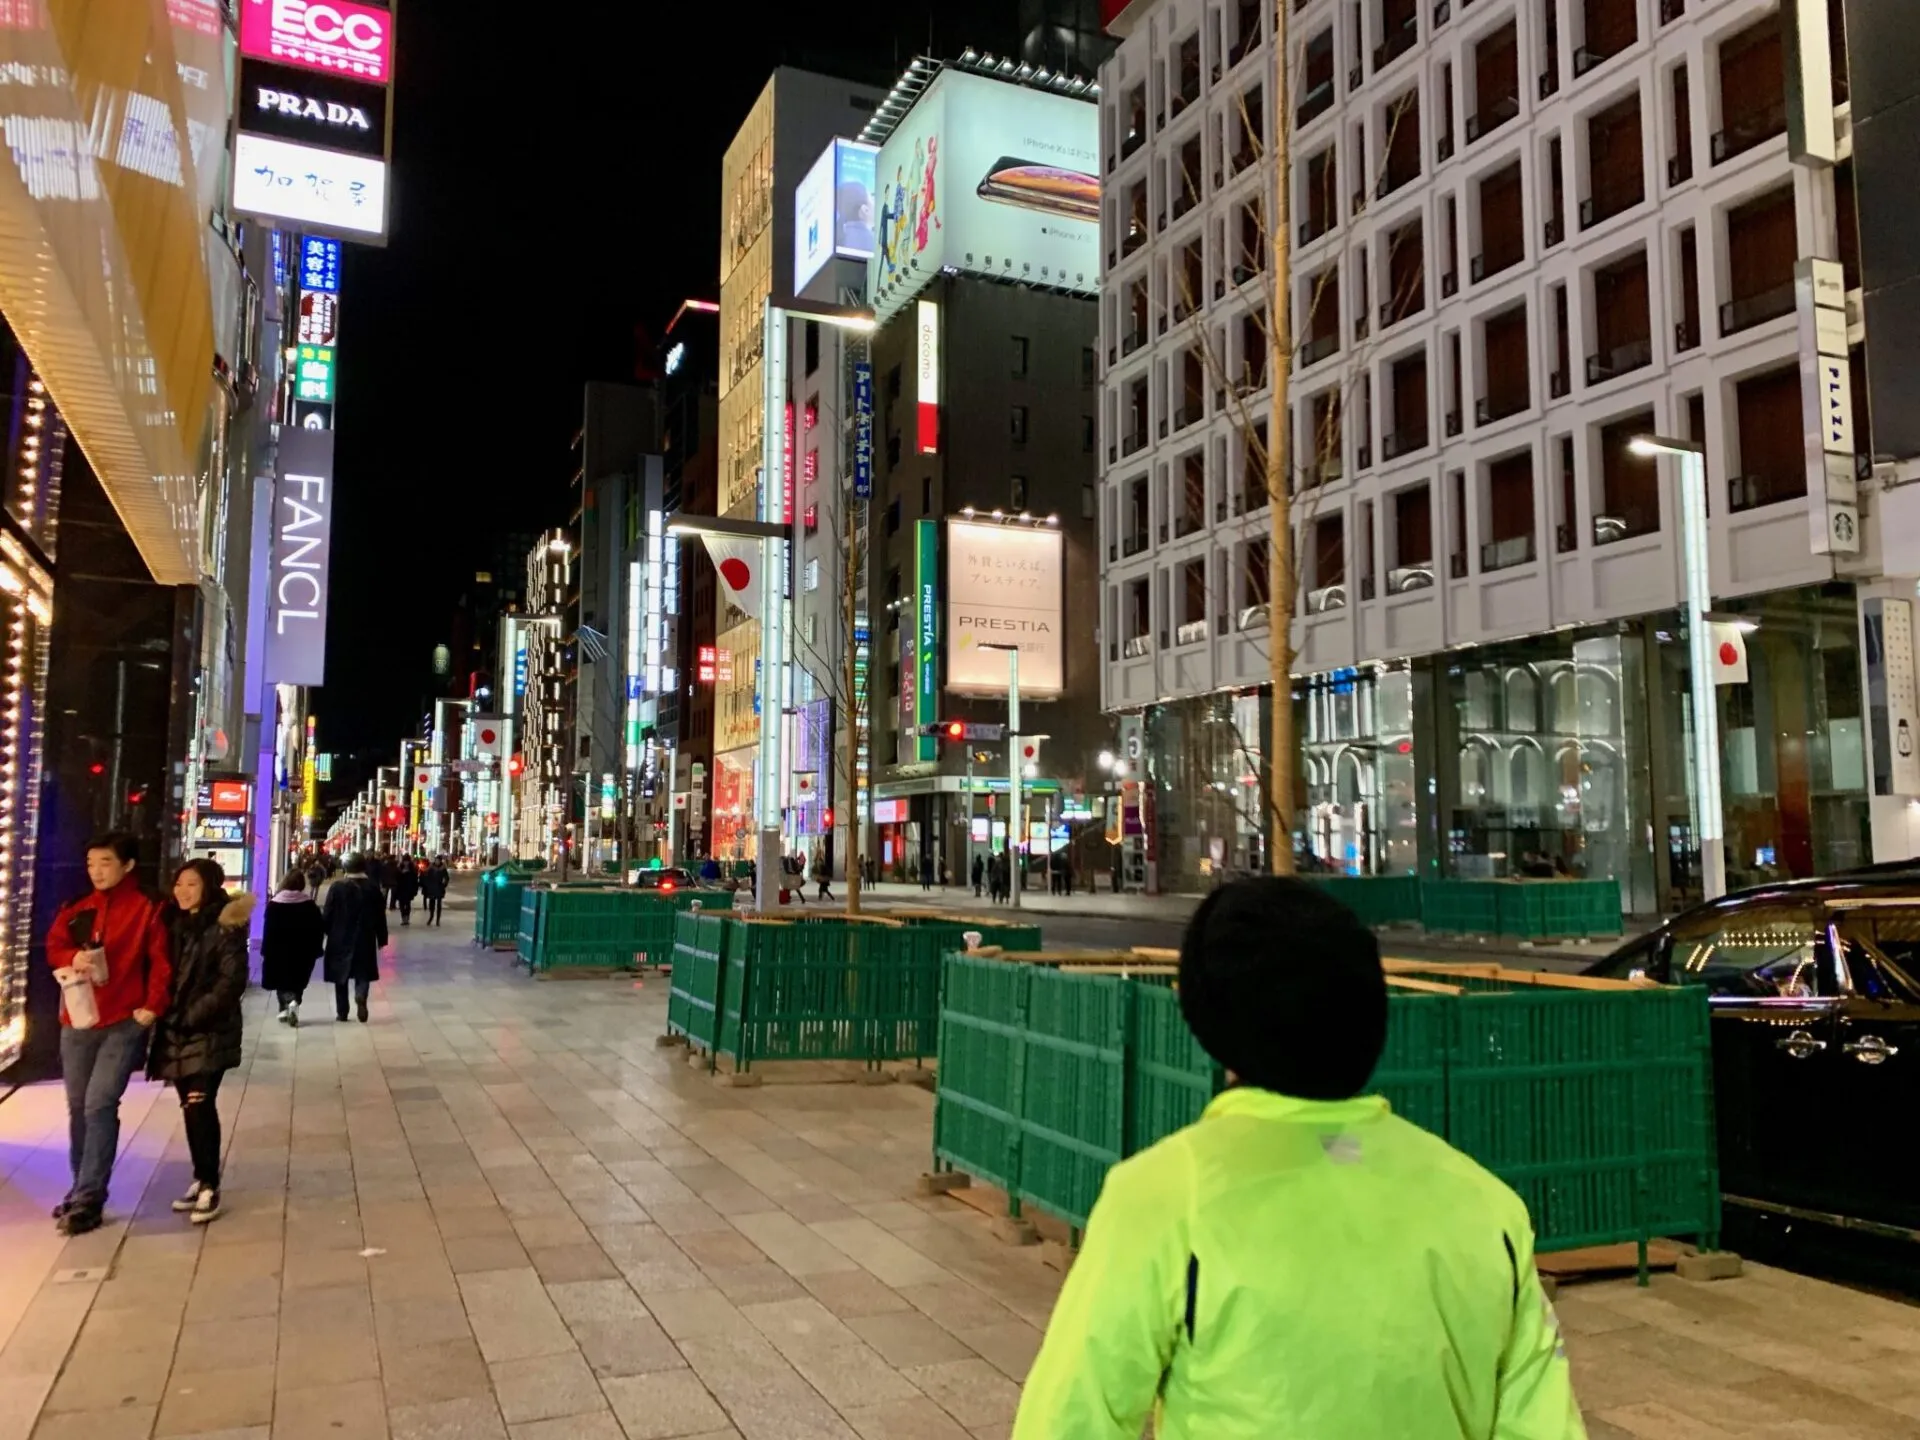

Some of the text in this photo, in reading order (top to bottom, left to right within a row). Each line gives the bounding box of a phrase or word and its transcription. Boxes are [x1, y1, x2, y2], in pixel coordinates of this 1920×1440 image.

[272, 0, 382, 50] ECC
[257, 88, 369, 129] PRADA
[305, 240, 325, 287] 美容室
[922, 324, 931, 380] docomo
[1828, 367, 1843, 442] PLAZA
[277, 473, 325, 635] FANCL
[959, 616, 1050, 633] PRESTIA
